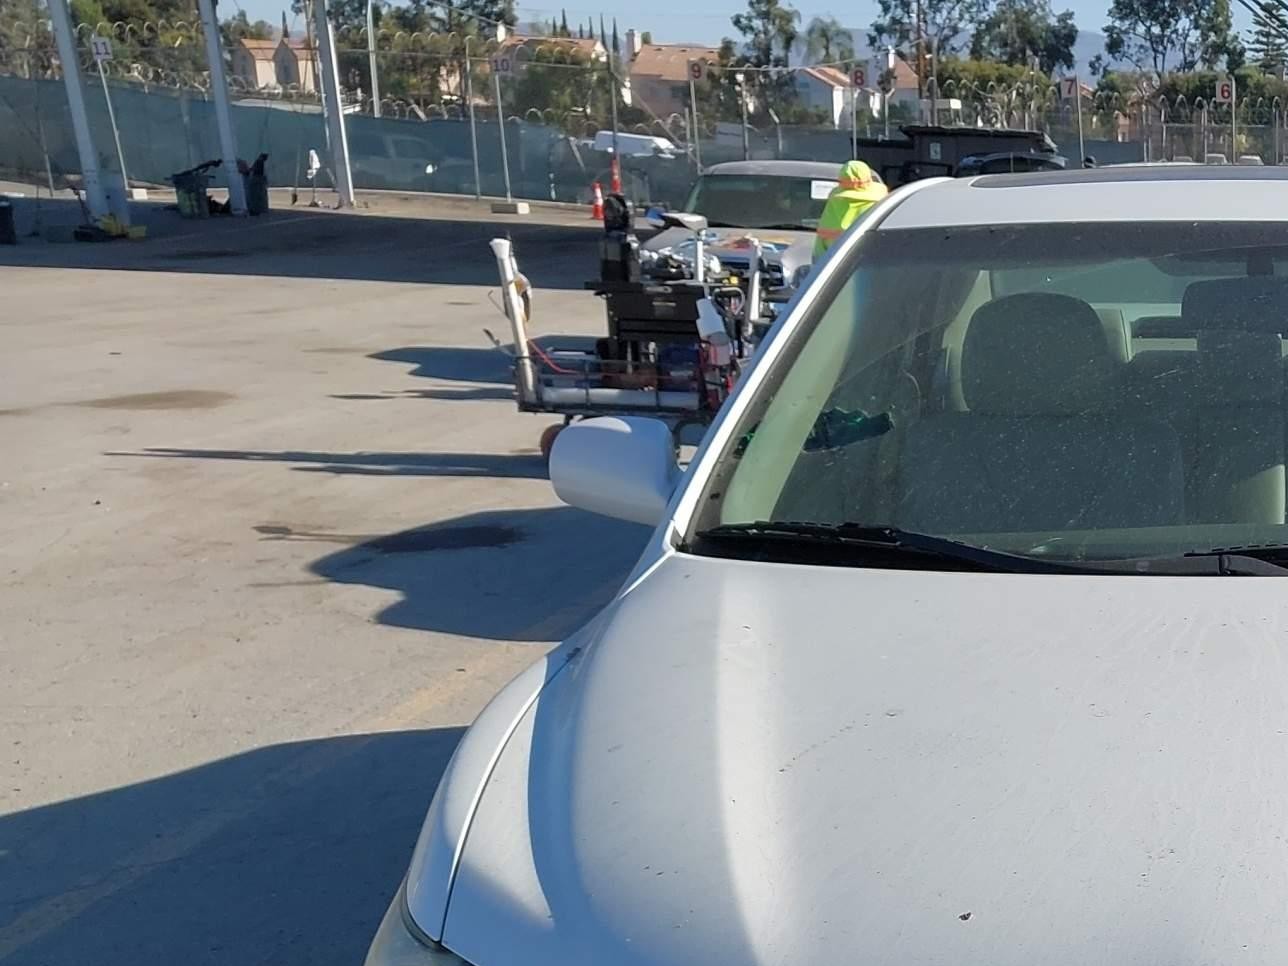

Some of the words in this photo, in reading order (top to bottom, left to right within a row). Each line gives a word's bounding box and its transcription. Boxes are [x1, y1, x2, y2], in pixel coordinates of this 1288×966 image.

[691, 63, 702, 79] 9
[854, 69, 865, 86] 8
[1064, 79, 1074, 95] 7
[1221, 83, 1231, 99] 6
